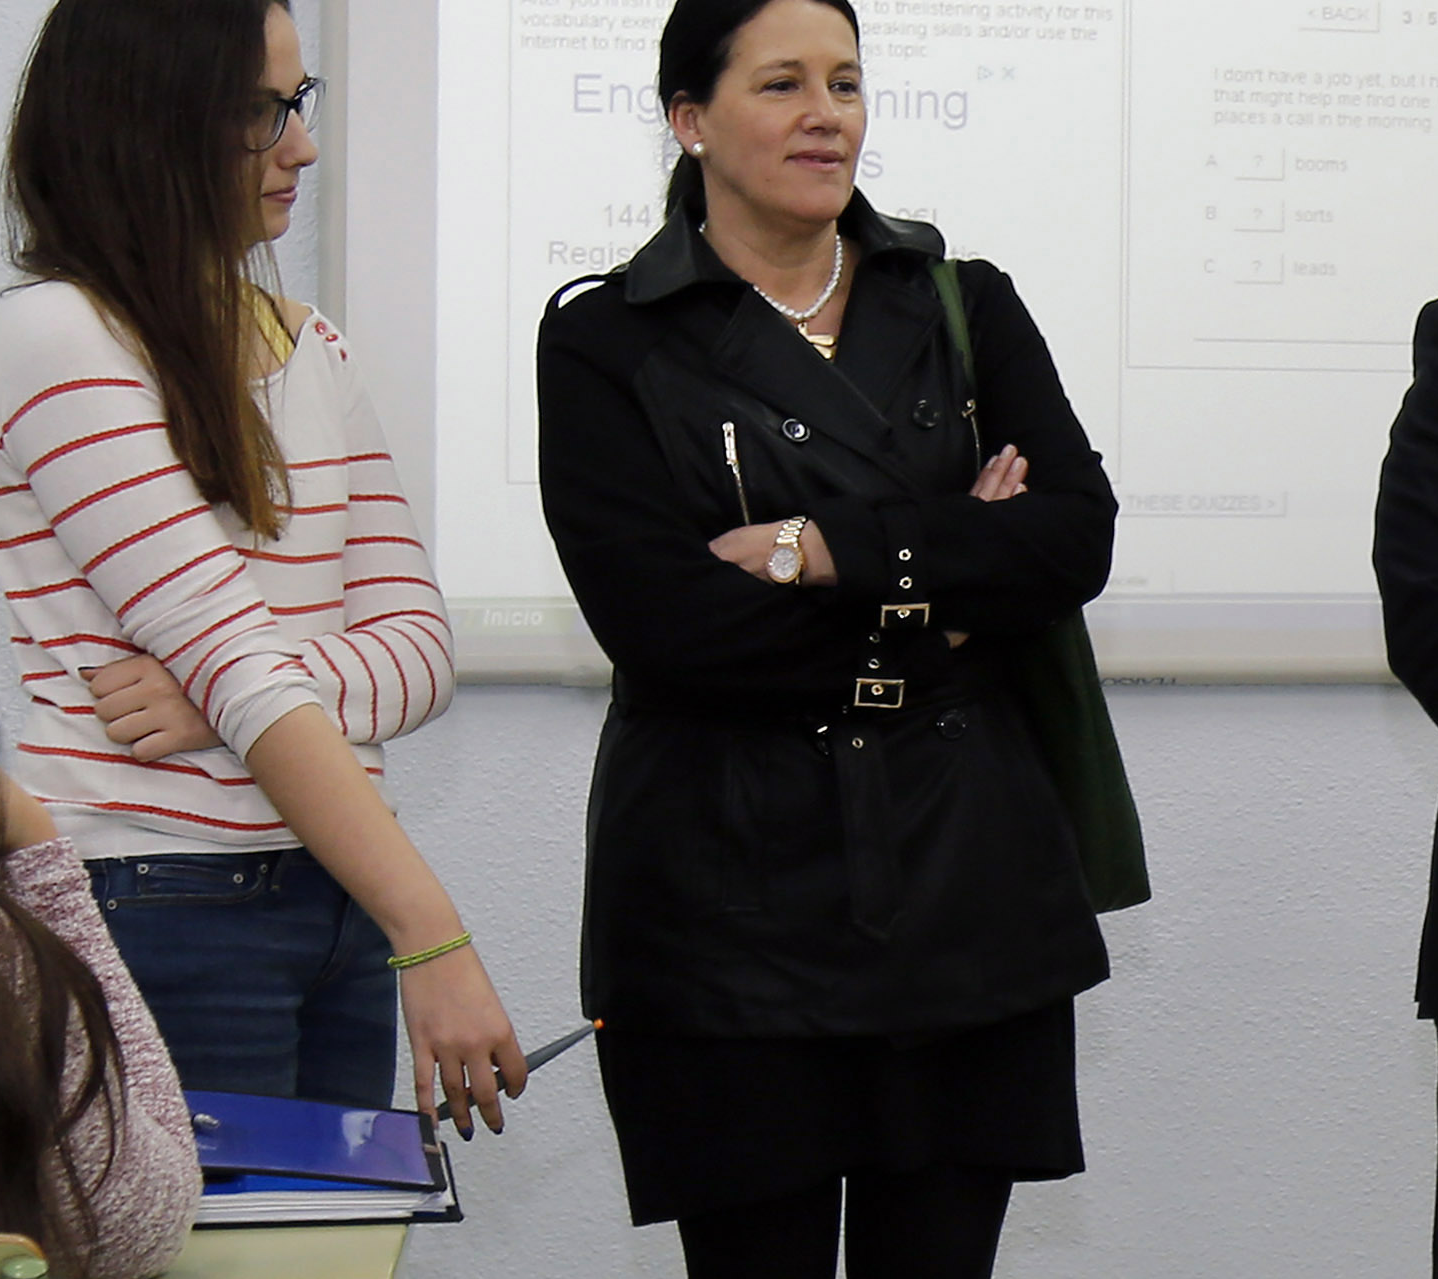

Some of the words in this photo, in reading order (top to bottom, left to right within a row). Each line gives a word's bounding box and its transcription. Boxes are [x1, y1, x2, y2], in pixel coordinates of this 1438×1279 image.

[874, 0, 889, 14] to
[996, 3, 1050, 21] activity
[1057, 4, 1079, 20] for
[1084, 7, 1113, 21] this
[1321, 7, 1368, 21] BACK
[1402, 11, 1412, 25] 3
[1427, 12, 1437, 25] 5
[521, 13, 612, 30] vocabulary
[933, 24, 971, 37] skills
[977, 25, 1030, 38] and/or
[1036, 29, 1066, 39] use
[1071, 27, 1098, 41] the
[521, 35, 588, 51] Internet
[592, 37, 608, 51] to
[614, 36, 645, 51] find
[888, 43, 928, 60] topic
[1224, 68, 1263, 83] don't
[1268, 70, 1307, 85] have
[1326, 72, 1352, 88] job
[1391, 75, 1416, 89] but
[1214, 89, 1245, 104] that
[1250, 89, 1294, 109] might
[1300, 91, 1331, 111] help
[1337, 96, 1362, 107] me
[1366, 93, 1395, 109] find
[1214, 110, 1267, 128] places
[1287, 112, 1314, 126] call
[1319, 113, 1332, 127] in
[1337, 113, 1362, 128] the
[1205, 154, 1218, 167] A
[1295, 157, 1347, 172] booms
[1205, 206, 1217, 219] B
[1295, 209, 1333, 223] sorts
[548, 242, 637, 271] Regis
[1203, 259, 1216, 274] C
[1294, 261, 1336, 276] leads
[1128, 495, 1184, 511] THESE
[1188, 496, 1262, 512] QUIZZES
[482, 610, 544, 627] Inicio
